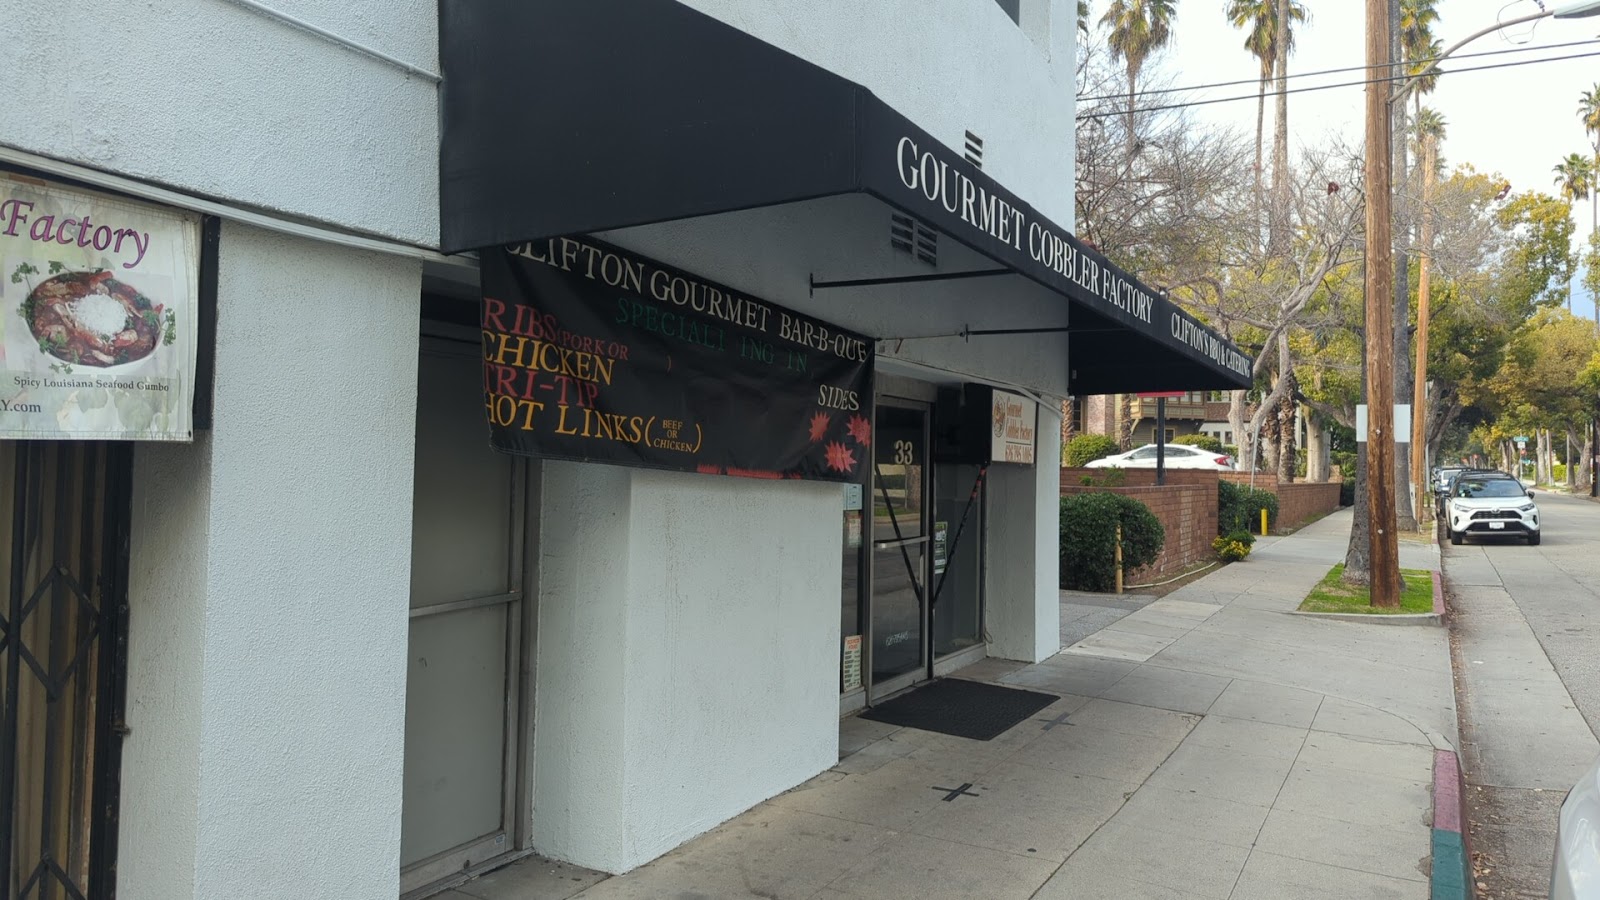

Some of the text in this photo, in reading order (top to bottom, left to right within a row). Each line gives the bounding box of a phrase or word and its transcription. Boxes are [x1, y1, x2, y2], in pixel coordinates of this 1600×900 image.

[0, 199, 149, 269] Factory
[897, 137, 1154, 324] GOURMET COBBLER FACTORY
[505, 237, 867, 362] LIFTON GOURMET BAR-B-QUE
[483, 297, 557, 342] RIBS
[608, 341, 628, 360] OR
[1171, 312, 1209, 355] CLIFTON'S
[1209, 335, 1220, 366] BBQ
[483, 330, 615, 385] CHICKEN
[787, 350, 808, 373] IN
[14, 376, 169, 391] Spicy Louisiana Seafood Gumbo
[484, 361, 599, 409] TRI-TIP
[817, 384, 860, 411] SIDES
[663, 420, 682, 430] BEEF
[667, 430, 677, 439] OR
[895, 440, 913, 465] 33
